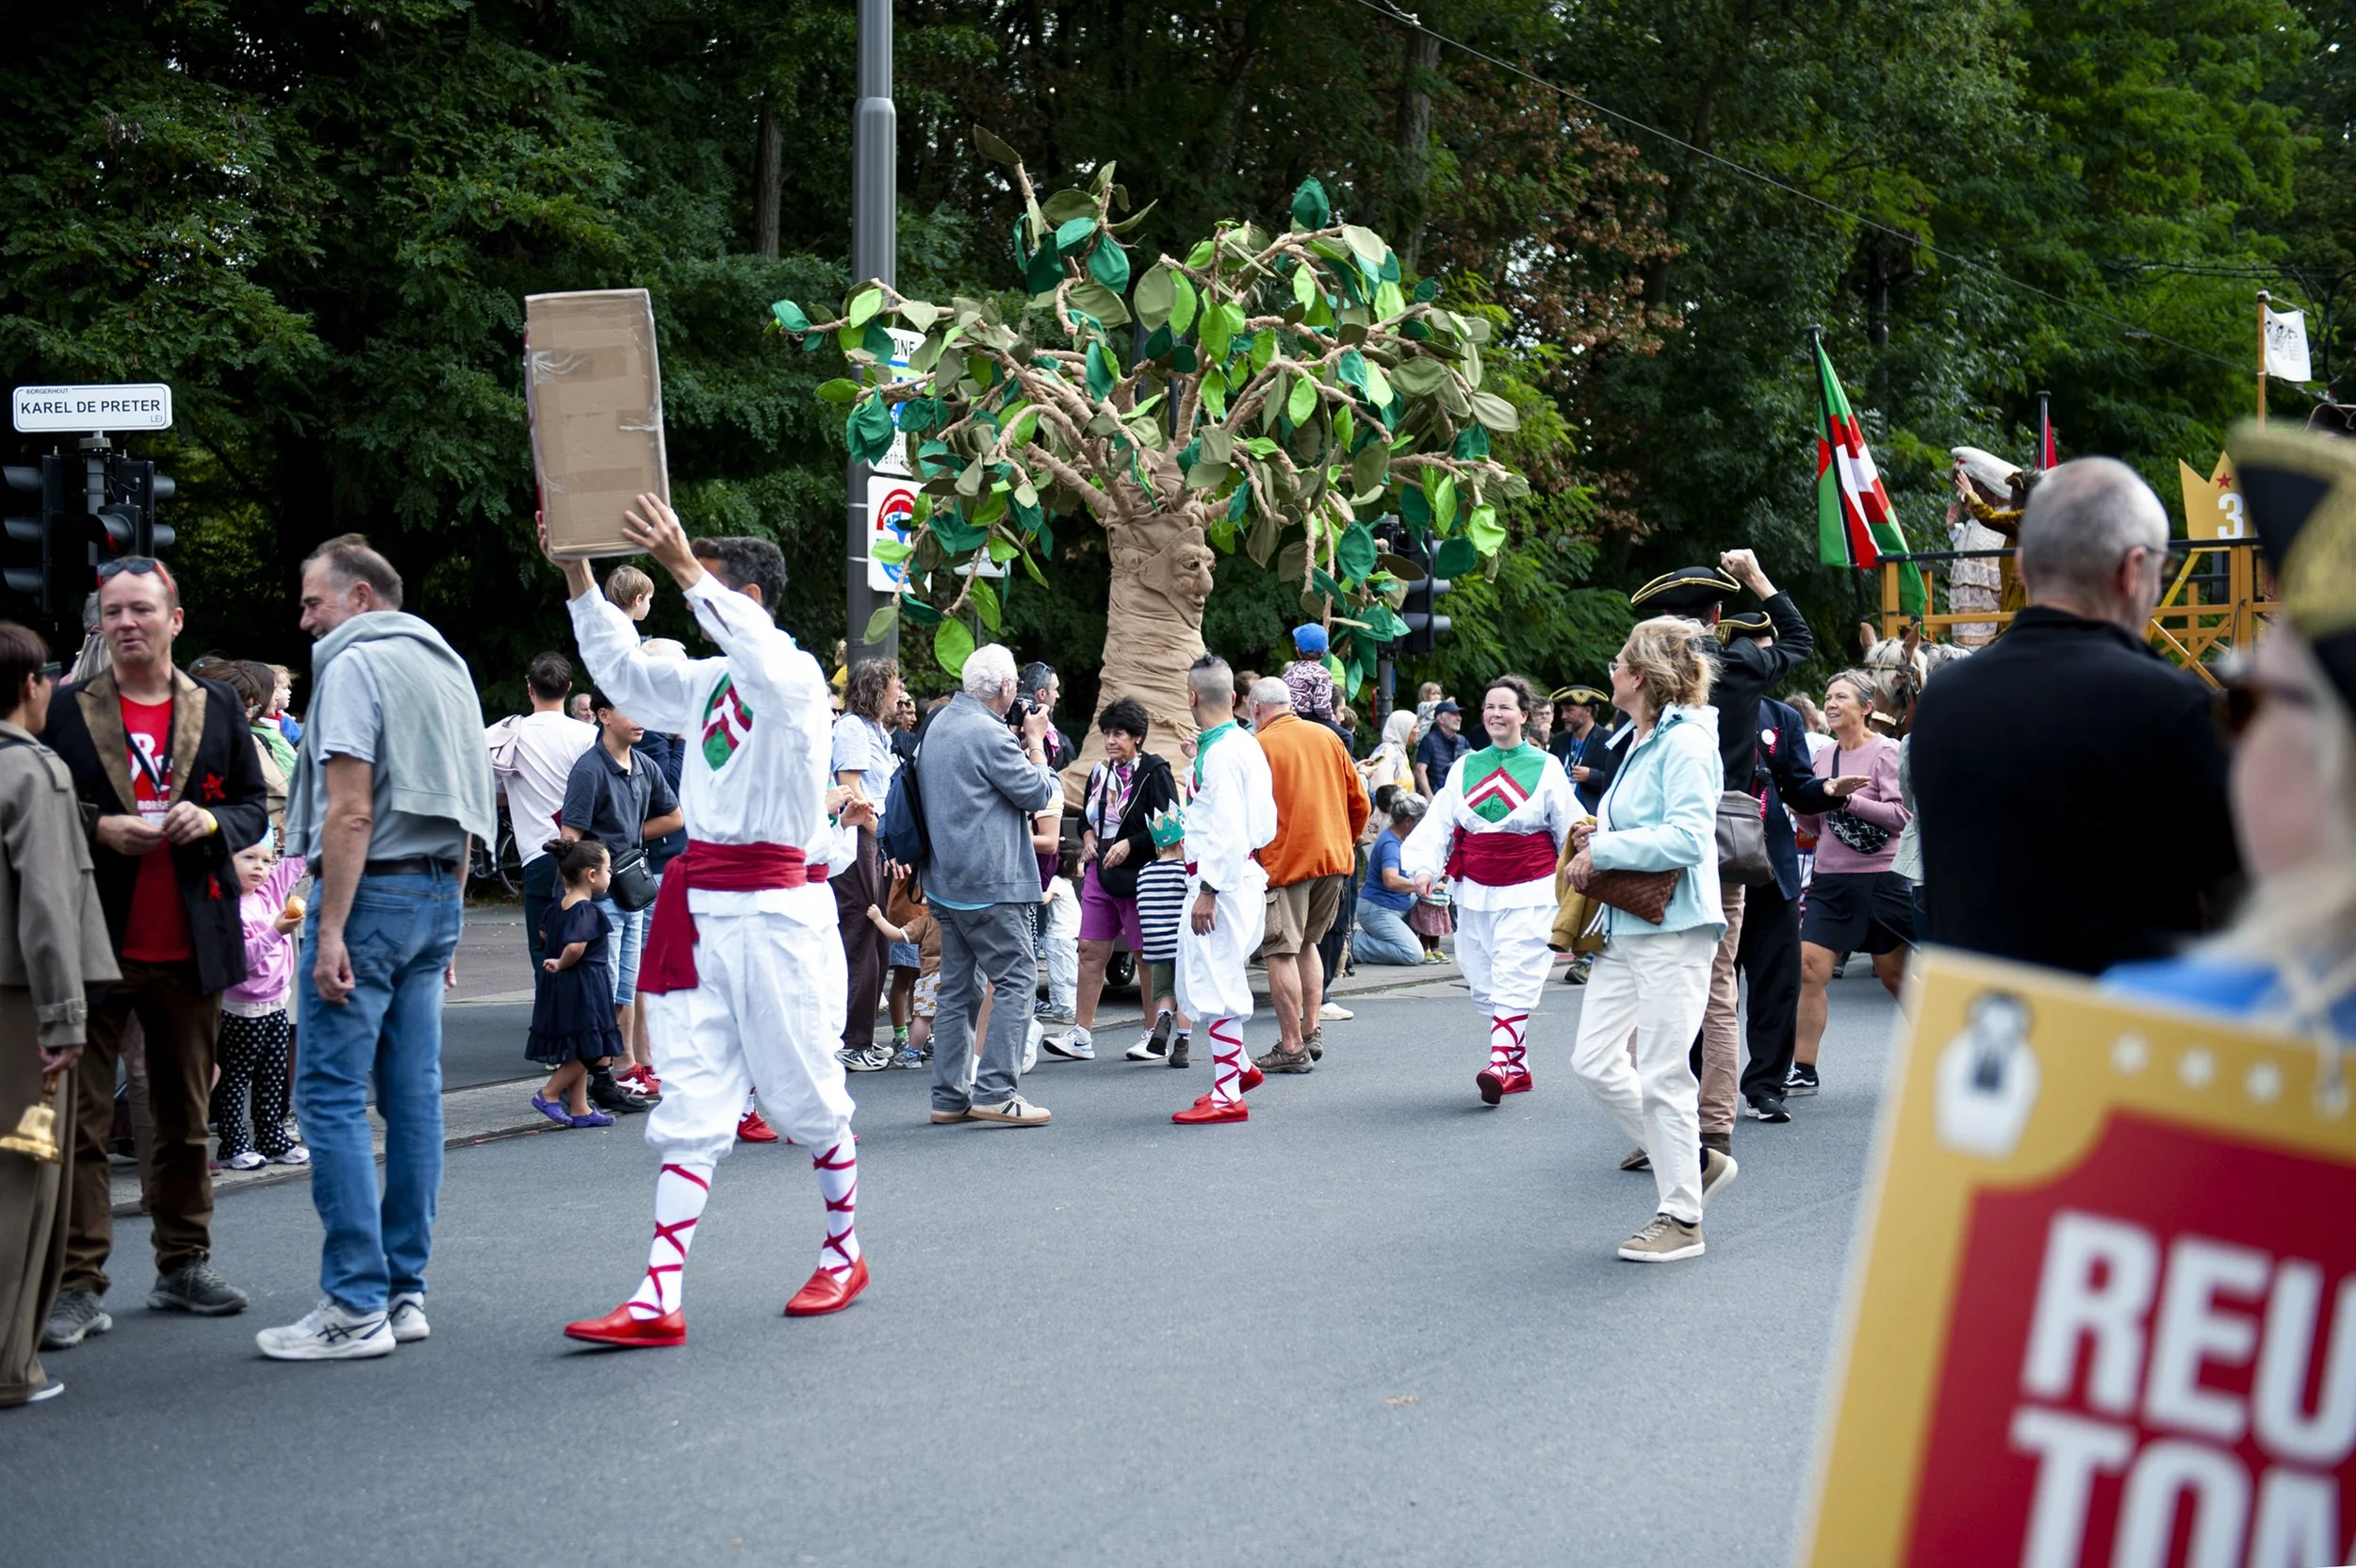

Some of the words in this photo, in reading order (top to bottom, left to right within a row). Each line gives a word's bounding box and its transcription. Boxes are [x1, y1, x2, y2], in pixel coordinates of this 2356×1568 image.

[893, 337, 915, 357] ONE
[21, 401, 73, 415] KAREL
[76, 401, 96, 413] DE
[101, 400, 161, 413] PRETER
[2217, 492, 2245, 540] 3
[2019, 1209, 2356, 1464] REU
